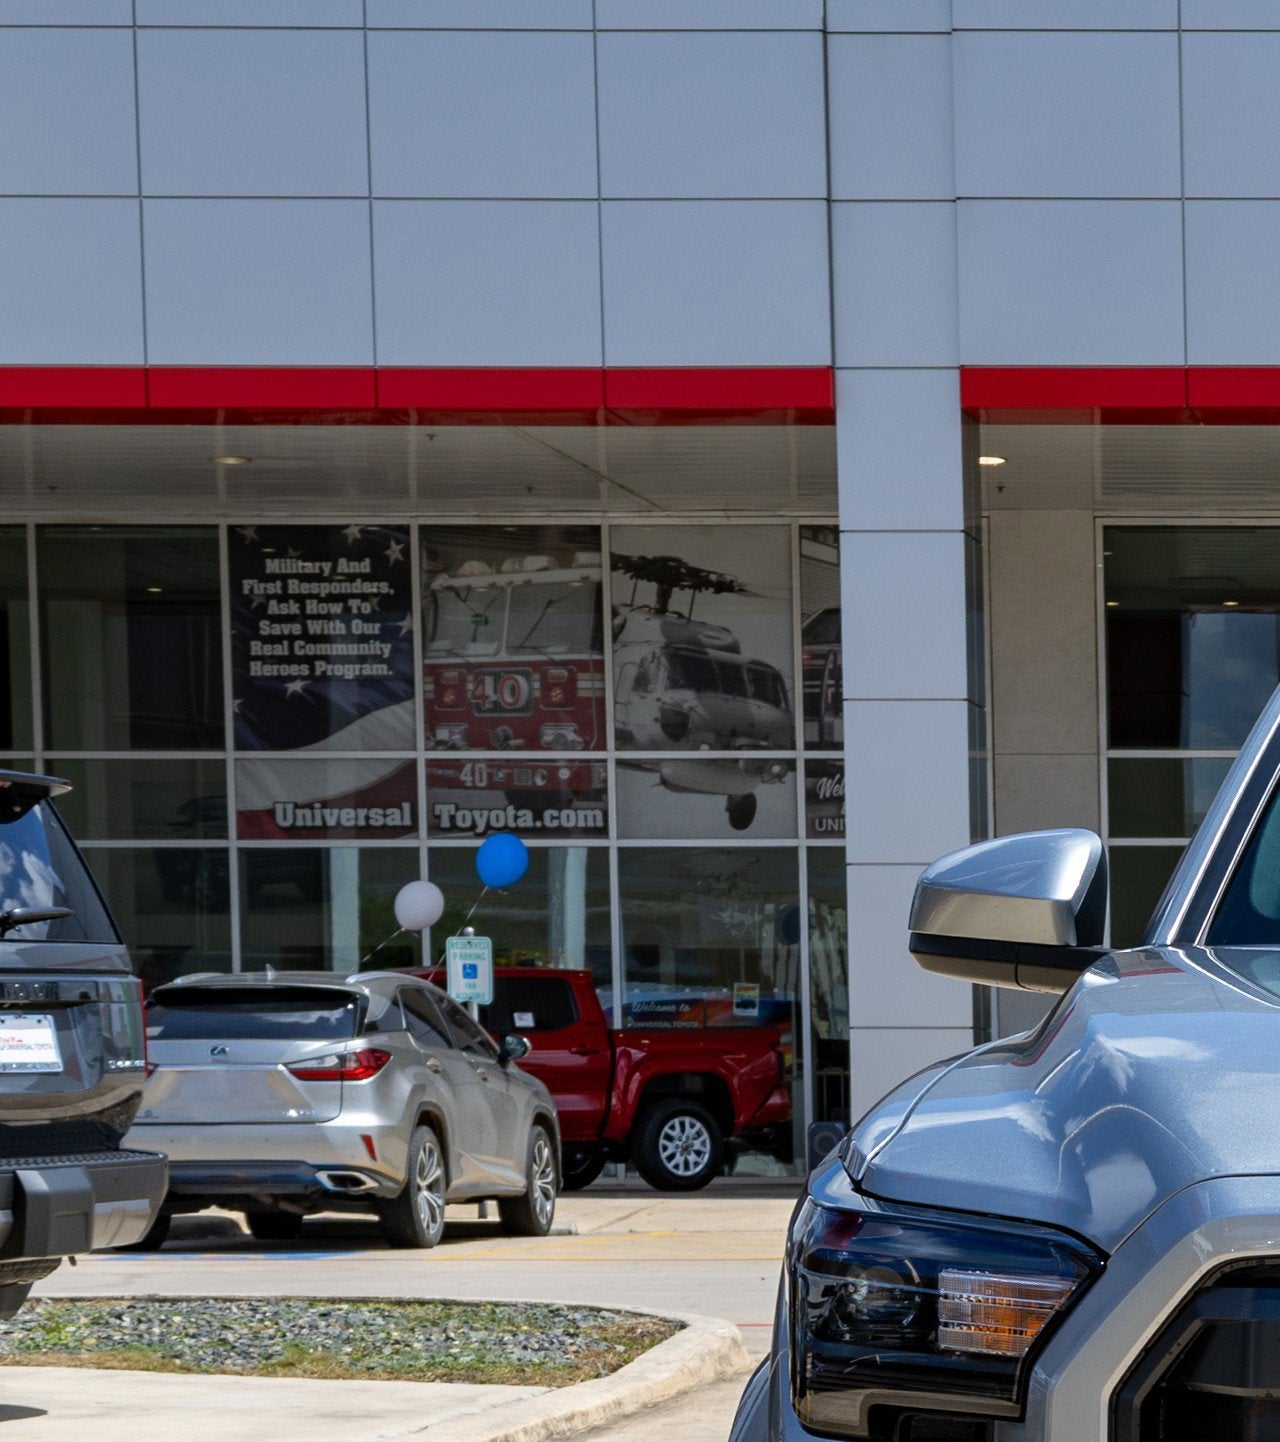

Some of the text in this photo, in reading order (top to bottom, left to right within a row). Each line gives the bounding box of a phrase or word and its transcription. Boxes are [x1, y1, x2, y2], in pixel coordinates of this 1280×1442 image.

[265, 557, 371, 577] Military And
[242, 578, 395, 597] First Responders,
[267, 599, 371, 615] Ask How To
[258, 619, 381, 636] Save With Our
[250, 639, 392, 659] Real Community
[249, 660, 394, 680] Heroes Program.
[471, 673, 529, 710] 40
[459, 762, 488, 788] 40
[274, 802, 604, 834] Universal Toyota.com
